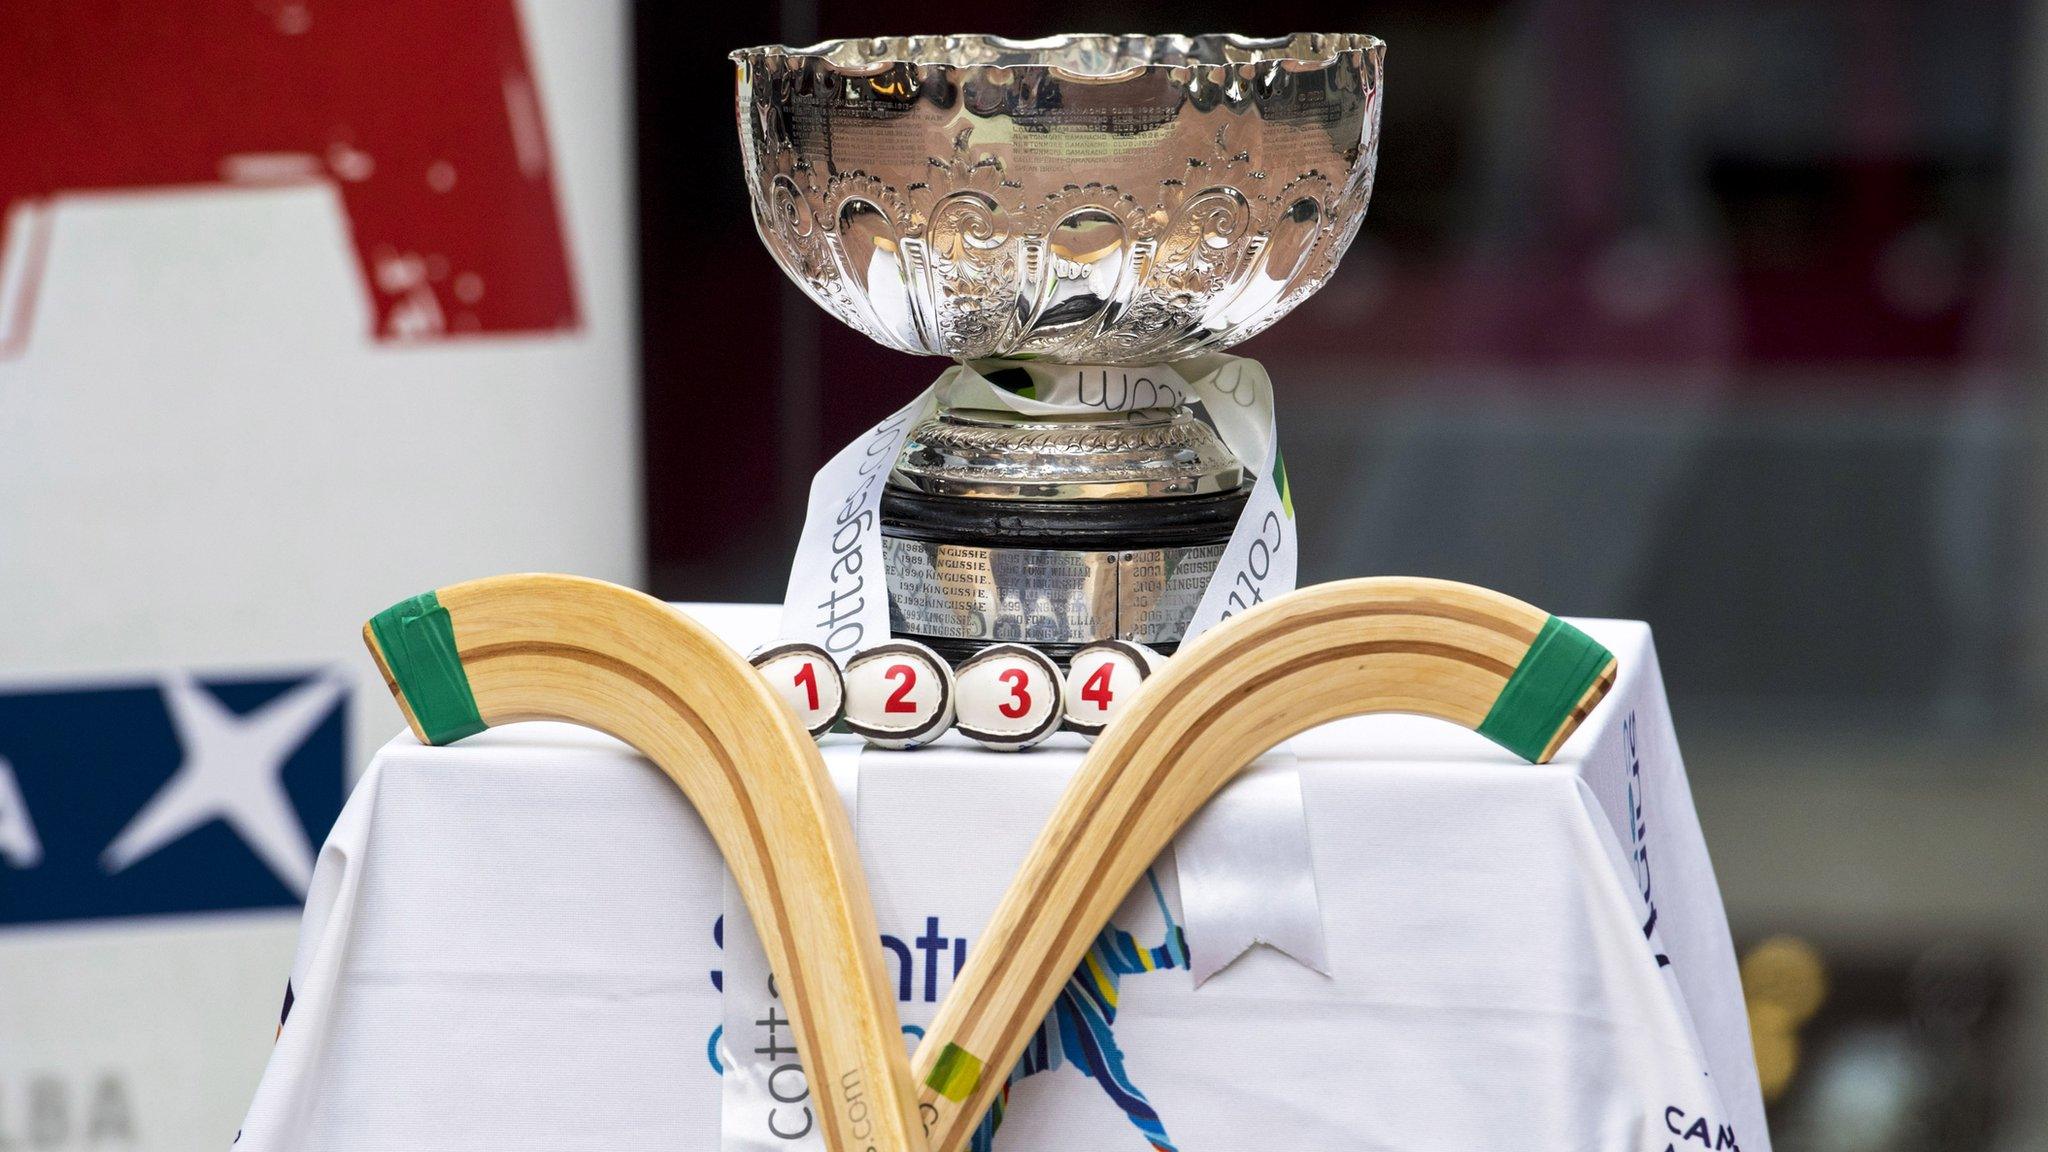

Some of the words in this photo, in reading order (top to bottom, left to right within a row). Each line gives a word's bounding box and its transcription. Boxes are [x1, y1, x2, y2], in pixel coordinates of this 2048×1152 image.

[794, 662, 819, 711] 1
[884, 664, 917, 713] 2
[999, 668, 1032, 719] 3
[1081, 662, 1115, 711] 4
